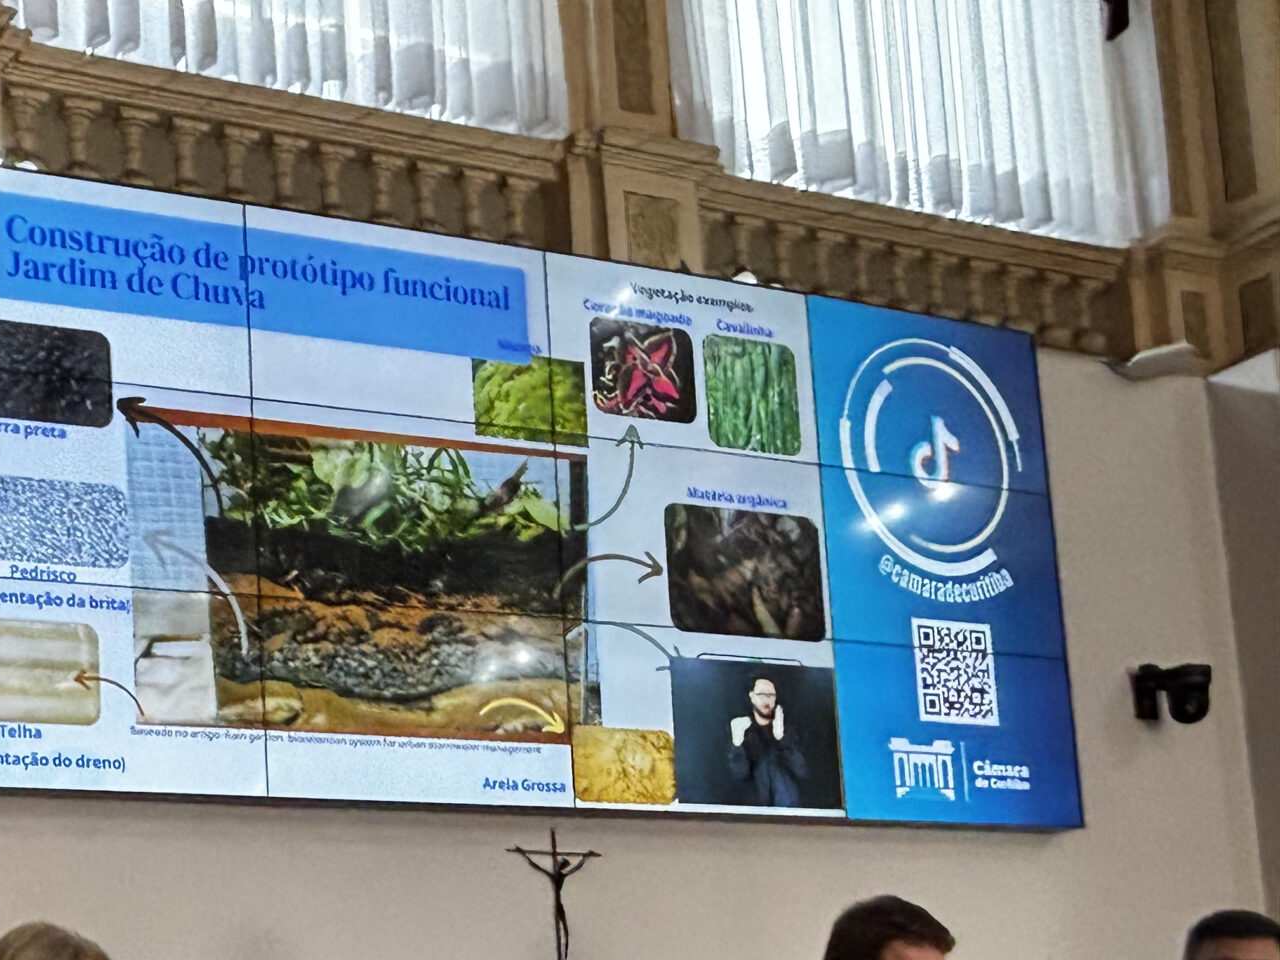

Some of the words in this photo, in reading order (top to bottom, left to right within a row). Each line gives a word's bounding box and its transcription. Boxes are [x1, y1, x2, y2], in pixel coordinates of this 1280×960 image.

[4, 213, 186, 268] Construção
[193, 242, 229, 271] de
[239, 254, 375, 296] protótipo
[383, 267, 510, 311] funcional
[6, 251, 118, 291] Jardim
[126, 262, 164, 296] de
[171, 272, 266, 310] Chuva
[24, 424, 67, 439] preta
[9, 564, 77, 583] Pedrisco
[878, 554, 1014, 603] @camaradecuritiba
[66, 594, 86, 608] da
[0, 724, 43, 739] Telha
[53, 753, 72, 768] do
[75, 754, 126, 773] dreno)
[521, 778, 567, 793] Grossa
